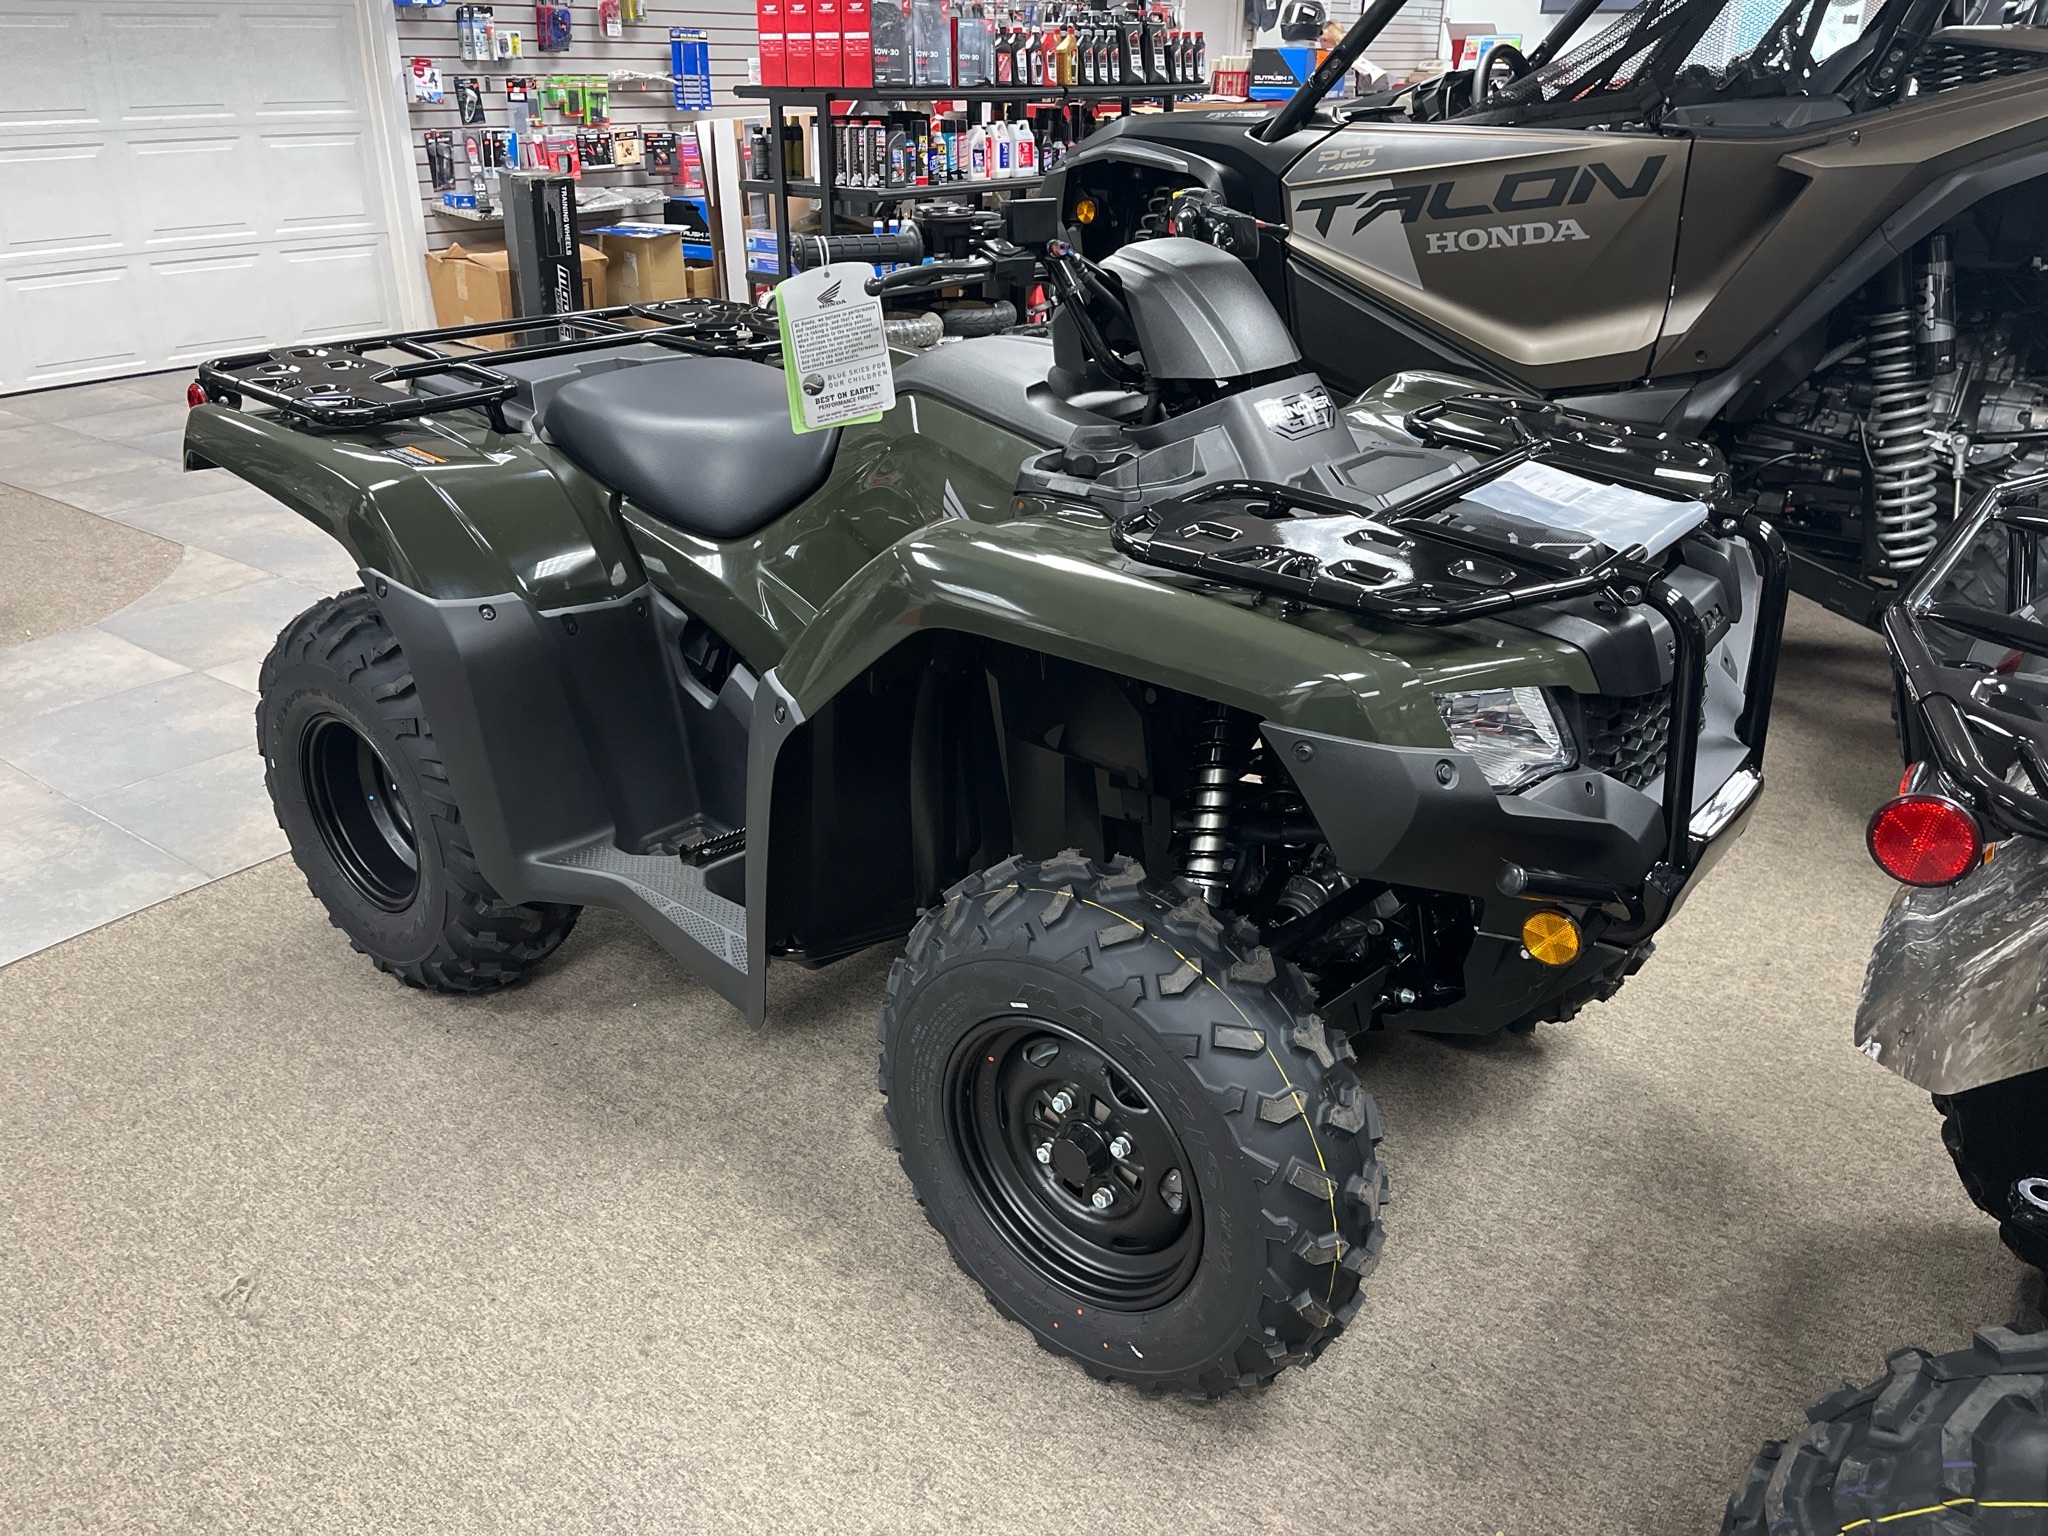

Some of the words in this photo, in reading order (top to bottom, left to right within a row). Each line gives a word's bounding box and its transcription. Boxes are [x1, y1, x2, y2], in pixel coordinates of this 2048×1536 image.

[874, 48, 899, 56] 10W-30
[1318, 144, 1383, 162] DCT
[1295, 154, 1668, 239] TALON
[560, 186, 570, 223] TRAINING
[564, 223, 572, 256] WHEELS
[682, 230, 704, 238] RUSH
[1426, 219, 1590, 254] HONDA
[819, 300, 846, 309] HONDA
[847, 305, 875, 315] performance
[829, 322, 852, 330] leadership
[850, 326, 879, 336] low-emission
[799, 344, 827, 354] technologies
[815, 346, 842, 356] powersports
[843, 341, 863, 349] products.
[851, 343, 878, 353] performance
[802, 362, 824, 370] everybody
[827, 371, 846, 380] BLUE
[848, 365, 869, 375] SKIES
[872, 361, 886, 369] FOR
[828, 380, 844, 388] OUR
[847, 369, 888, 383] CHILDREN
[814, 394, 835, 404] BEST
[836, 391, 847, 399] ON
[818, 397, 856, 410] PERFORMANCE
[1014, 982, 1226, 1191] MAXXIS
